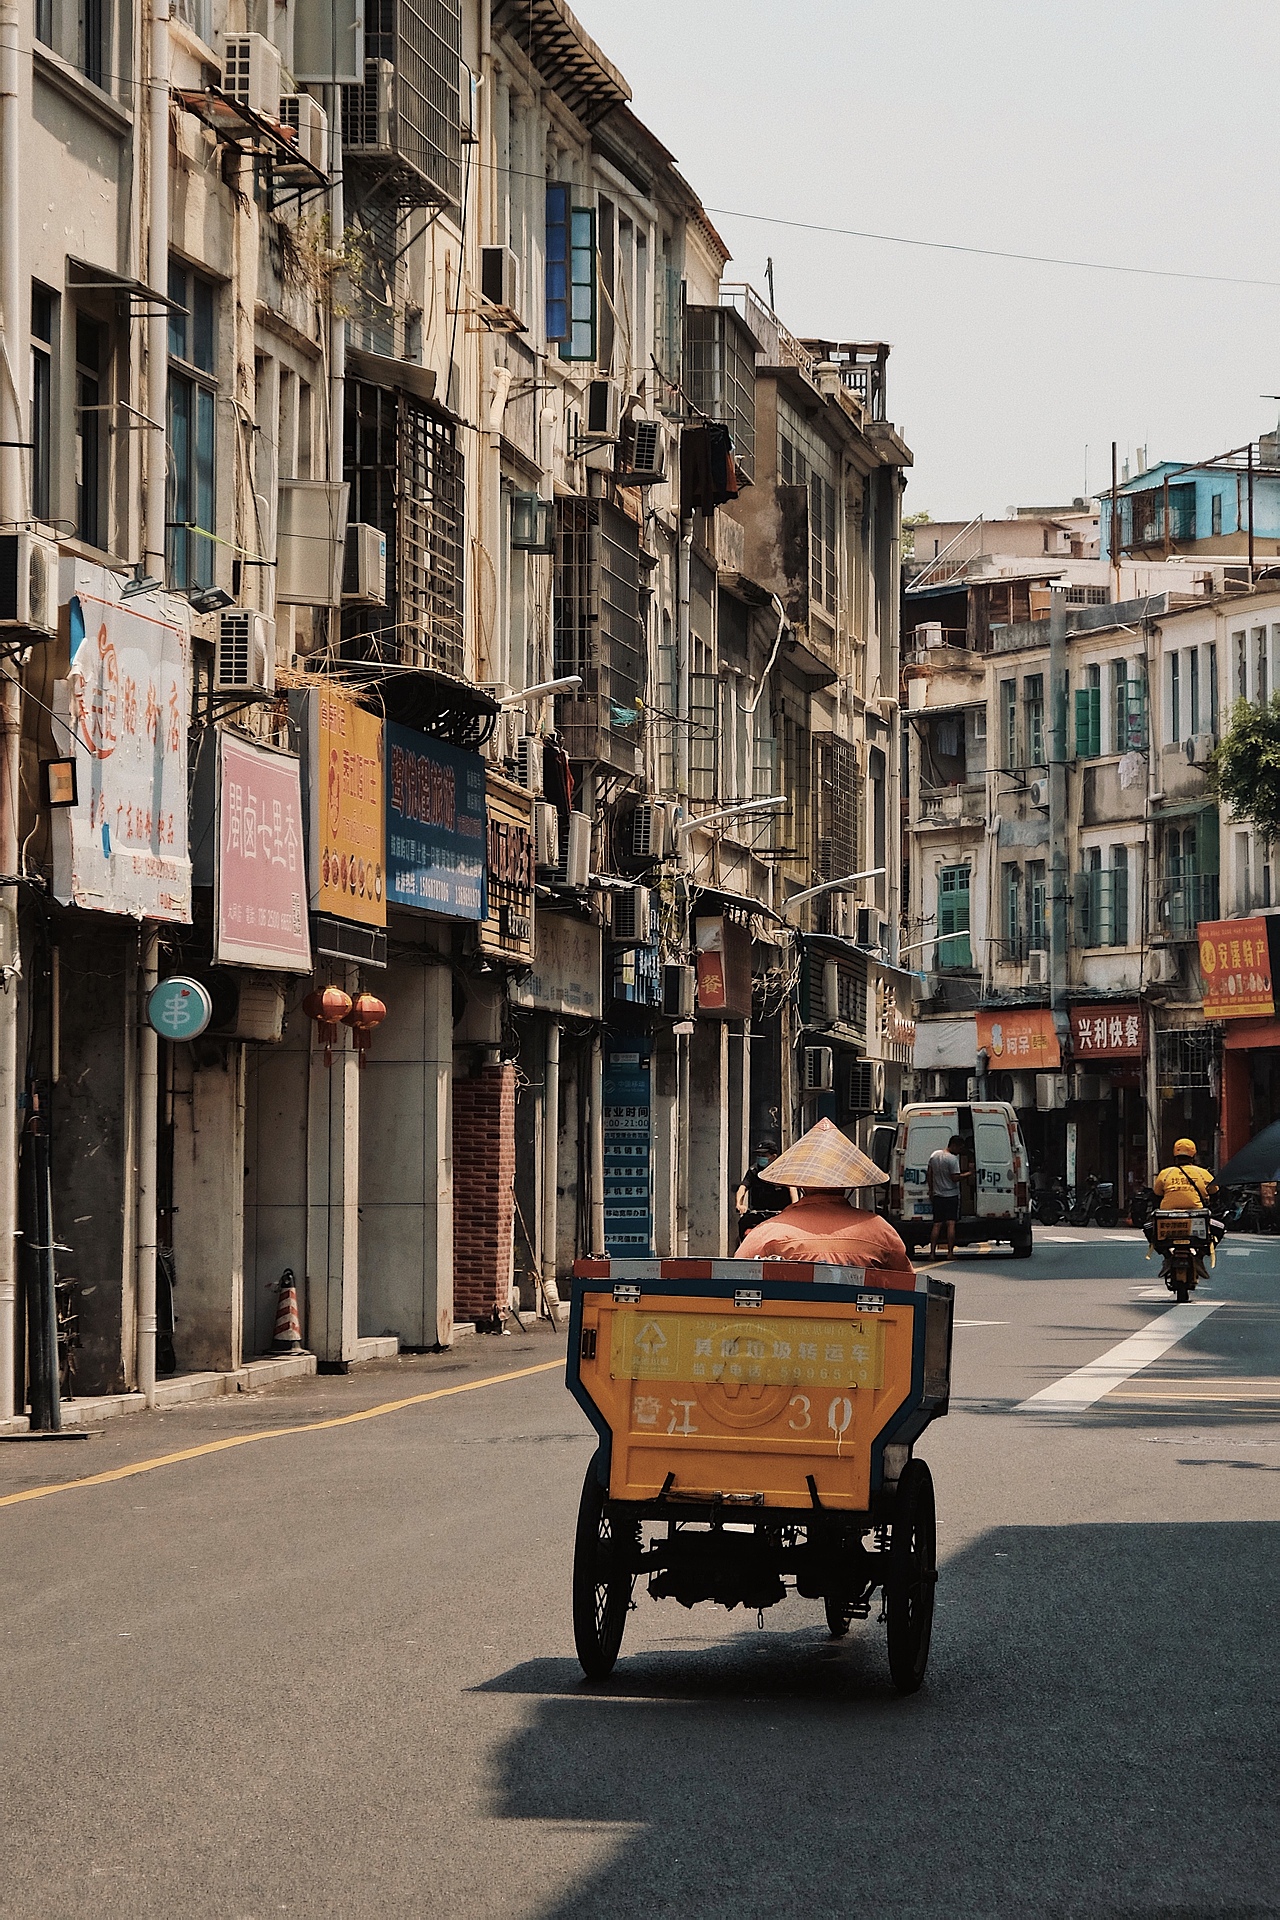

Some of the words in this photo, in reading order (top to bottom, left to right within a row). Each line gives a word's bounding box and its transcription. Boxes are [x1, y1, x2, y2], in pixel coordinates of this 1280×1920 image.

[1217, 939, 1266, 970] 安溪特产
[701, 974, 722, 994] 餐
[1078, 1014, 1139, 1050] 兴利快餐
[692, 1337, 871, 1364] 其他垃圾转运车
